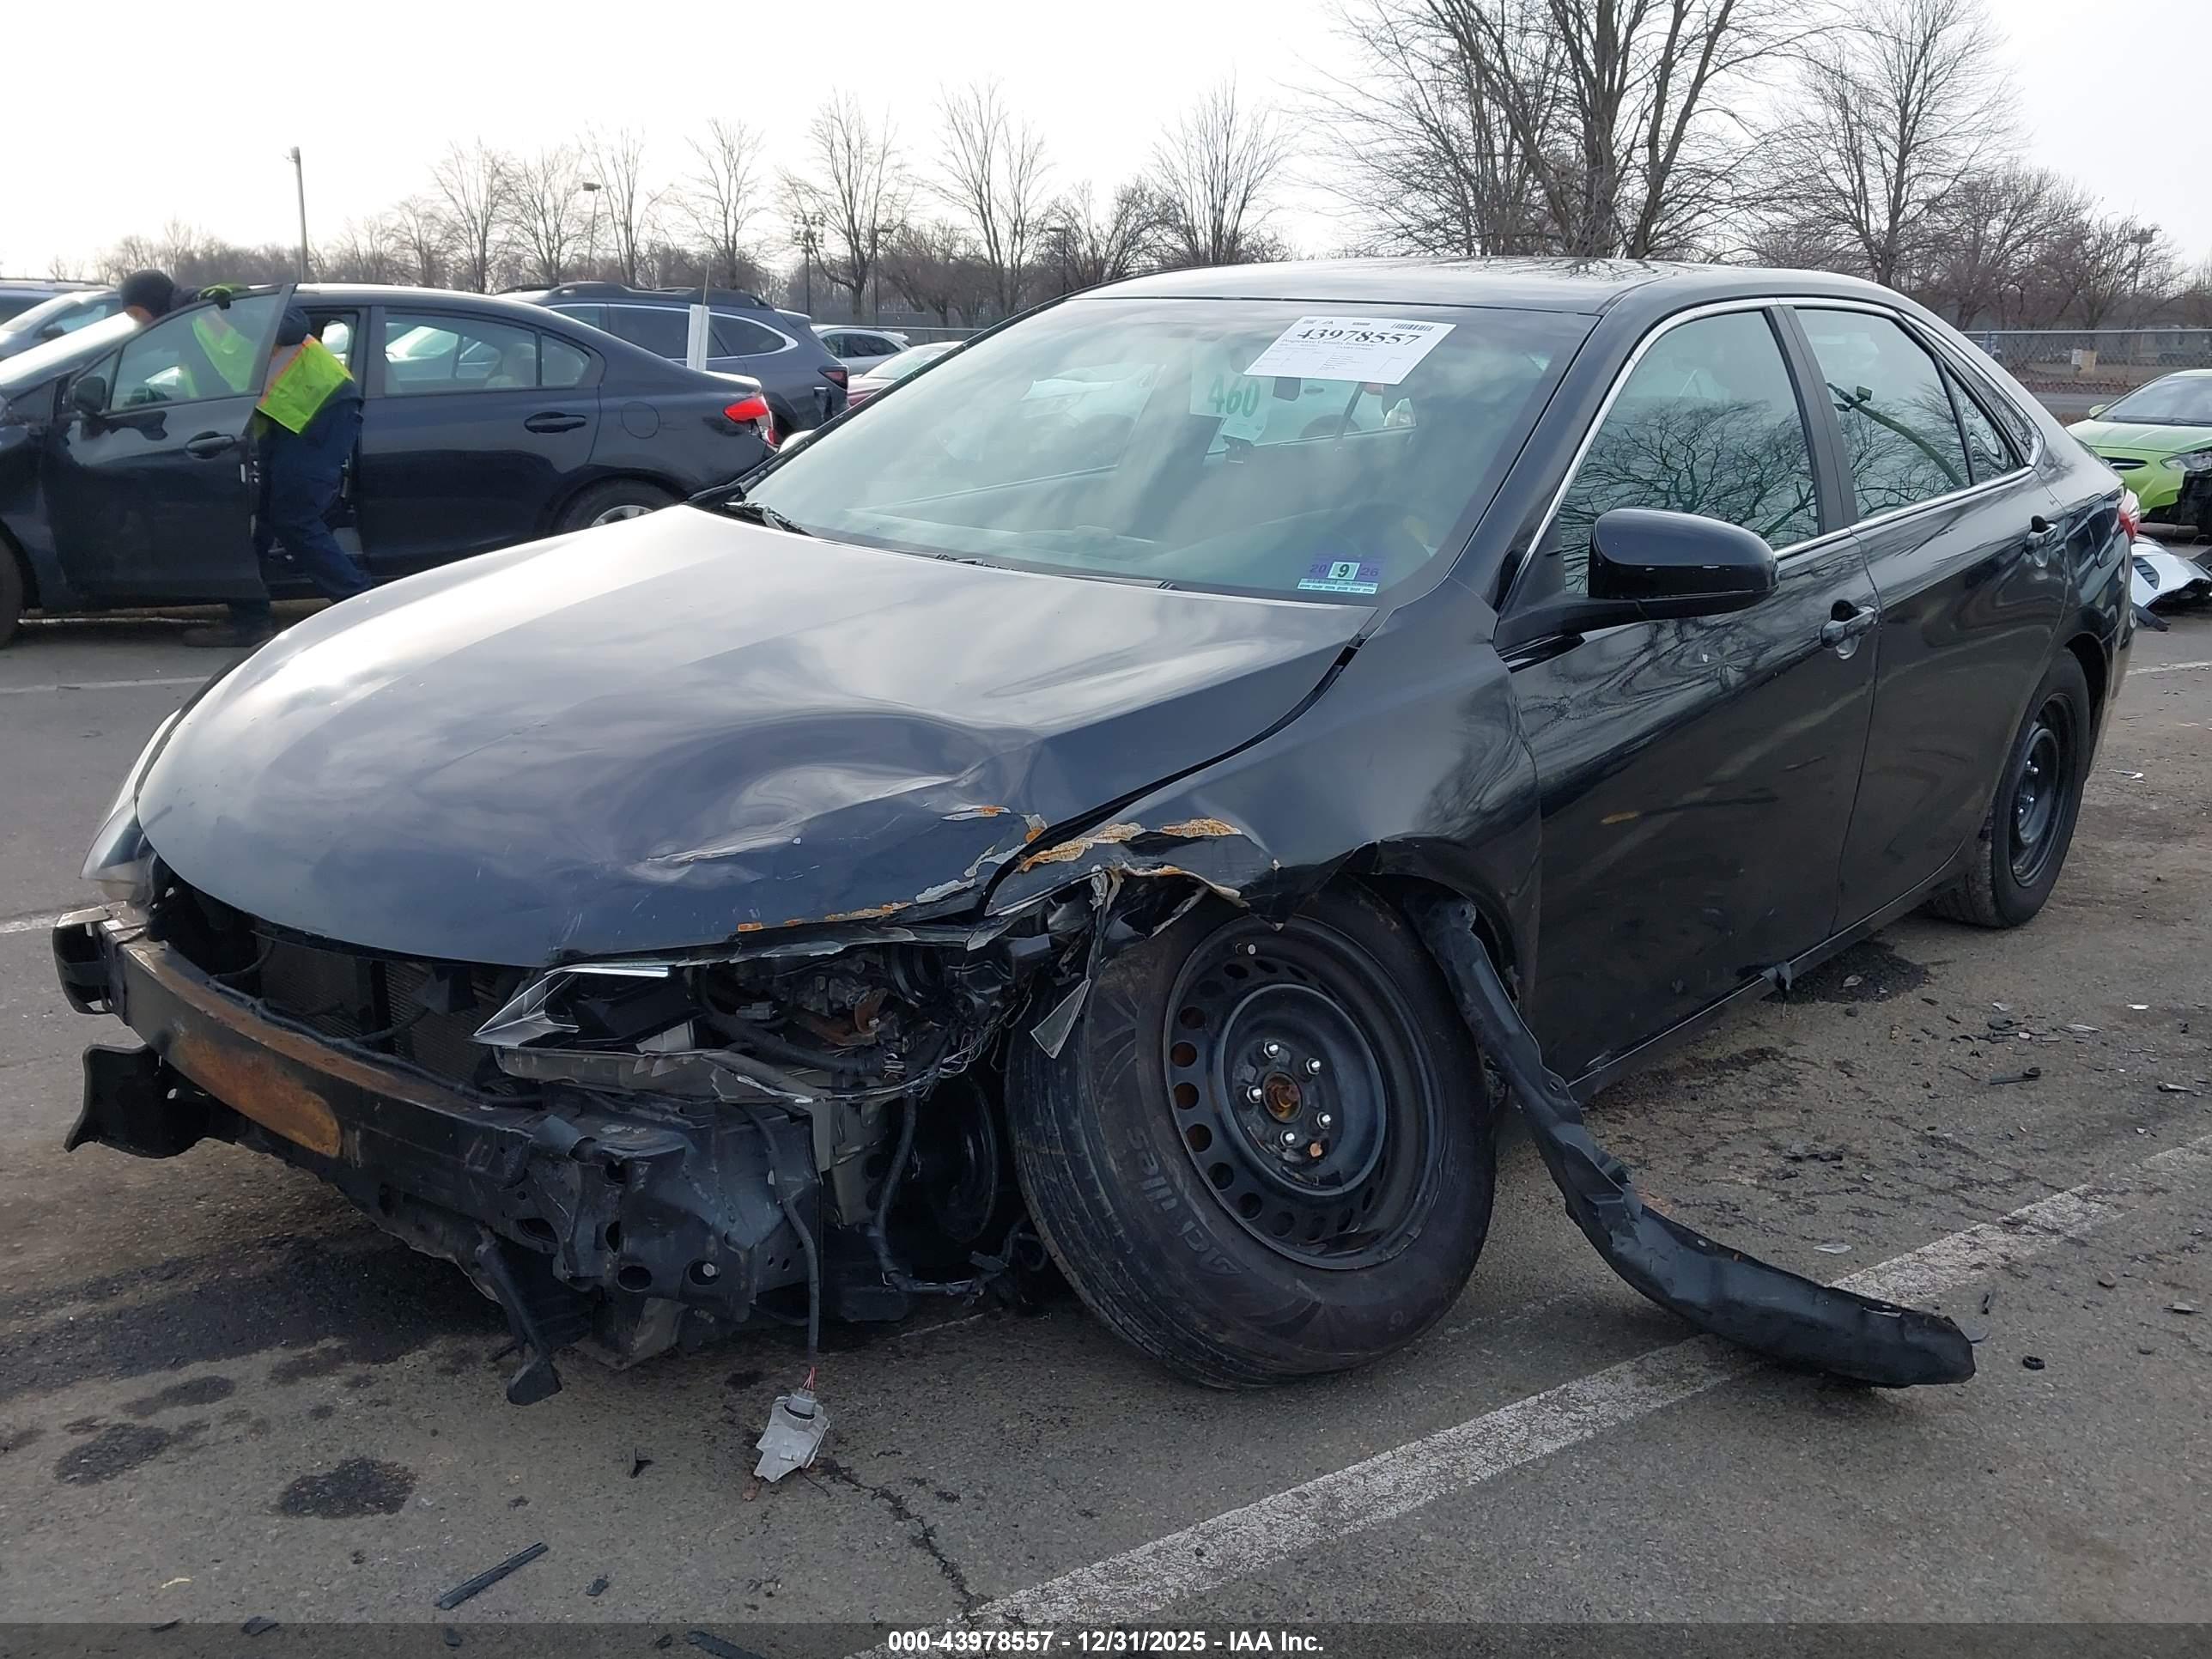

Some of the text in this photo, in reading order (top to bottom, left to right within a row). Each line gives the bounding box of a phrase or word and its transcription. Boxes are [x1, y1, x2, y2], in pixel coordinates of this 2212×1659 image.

[1297, 327, 1423, 346] 43978557
[1207, 373, 1261, 418] 460
[1337, 563, 1350, 578] 9
